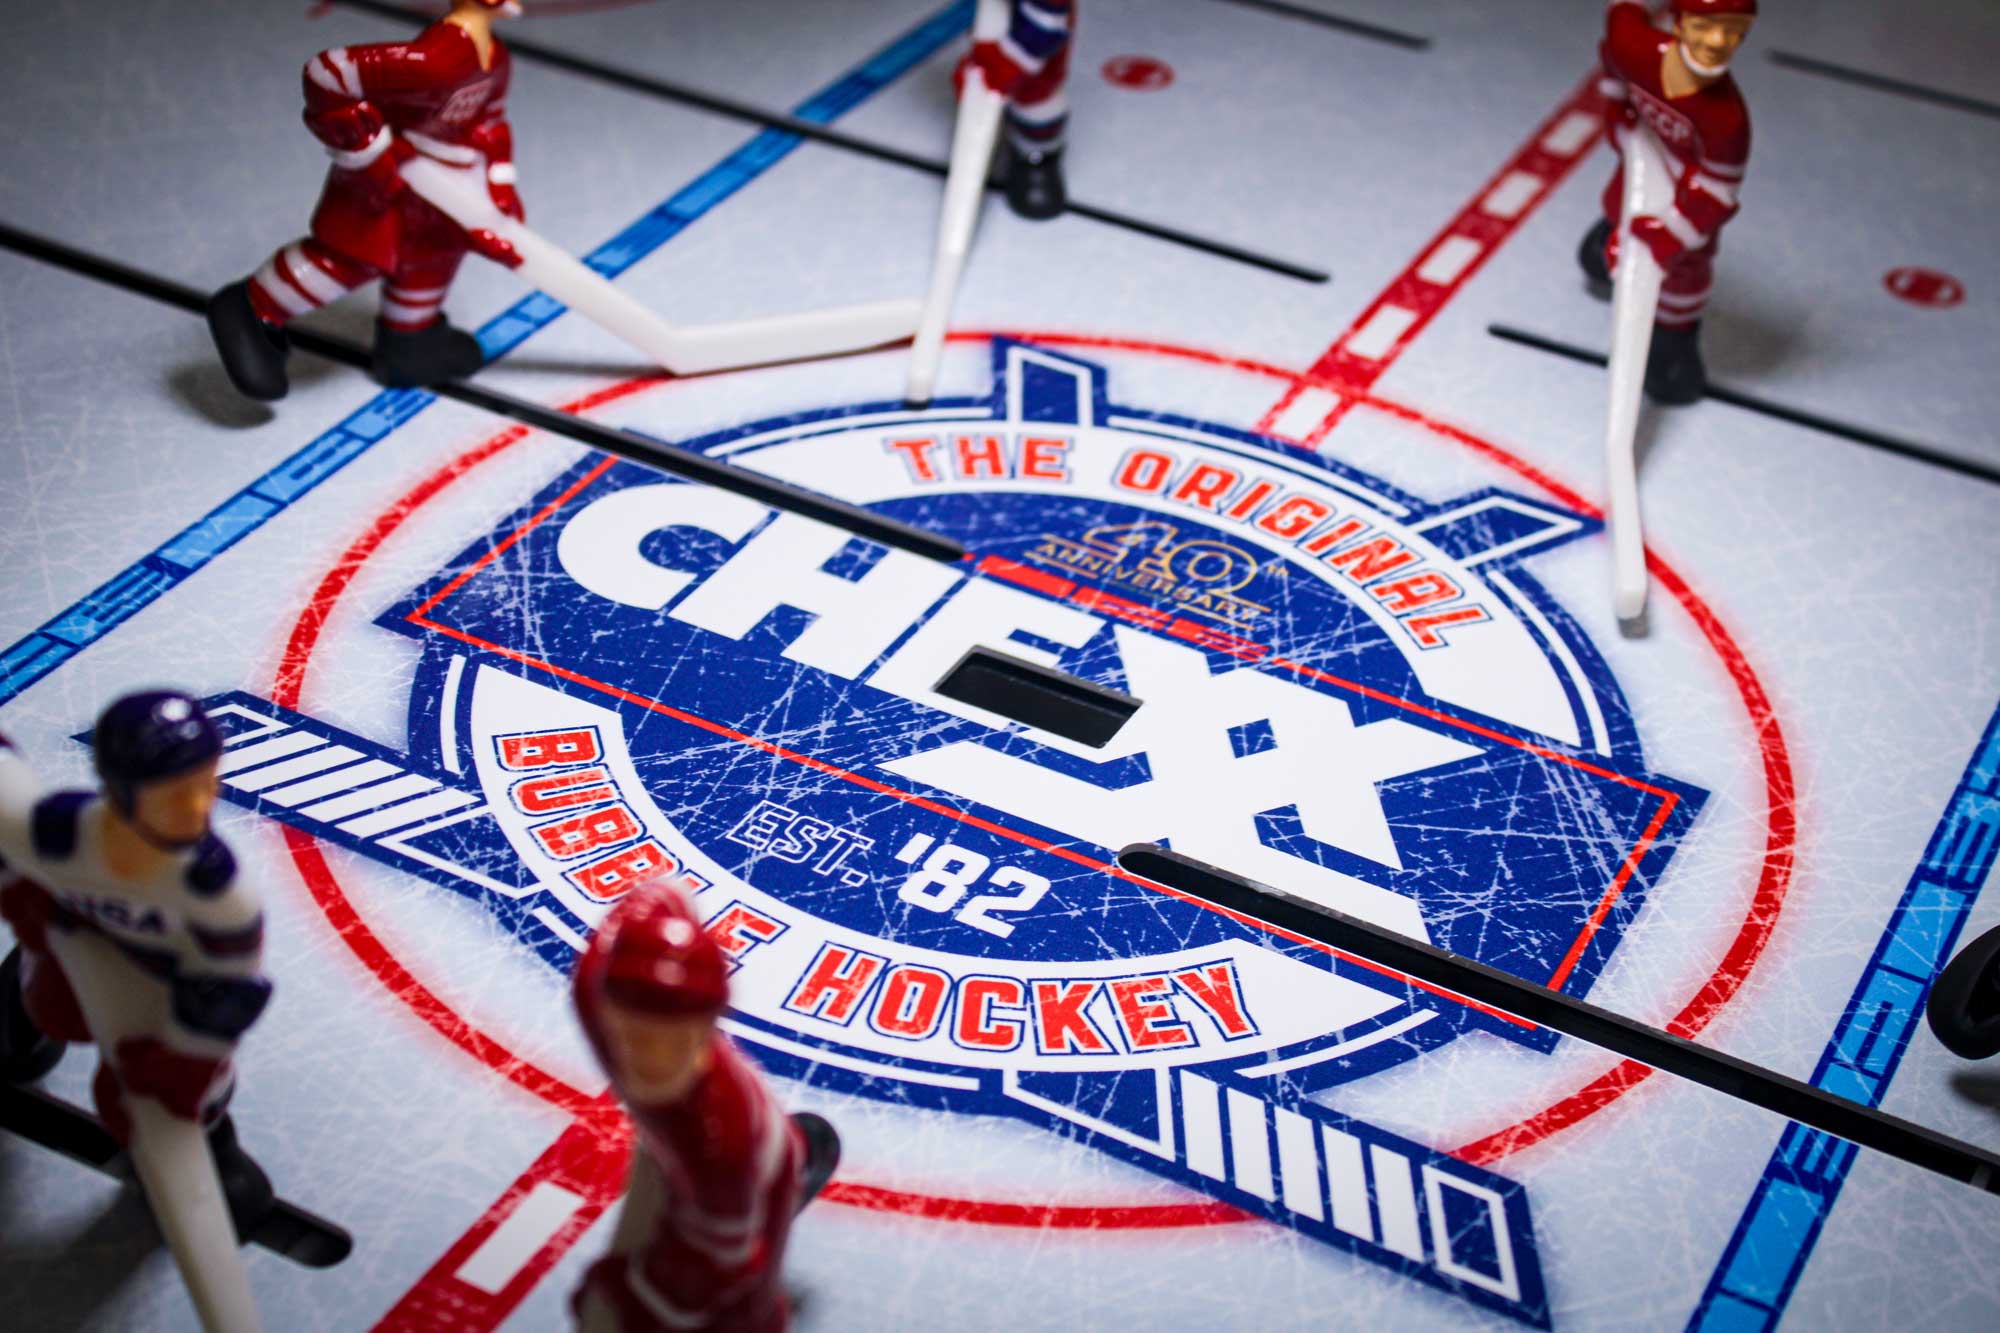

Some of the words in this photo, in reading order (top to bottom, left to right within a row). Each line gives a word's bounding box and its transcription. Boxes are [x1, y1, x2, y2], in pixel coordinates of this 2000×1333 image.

[886, 432, 1073, 485] THE
[1111, 444, 1494, 650] ORIGINAL
[1036, 542, 1262, 620] ANNIVERSARY
[557, 483, 1487, 945] CHEXX
[492, 725, 791, 980] BUBBE
[782, 958, 1260, 1056] HOCKEY
[726, 800, 875, 887] EST.
[896, 832, 1051, 938] '82
